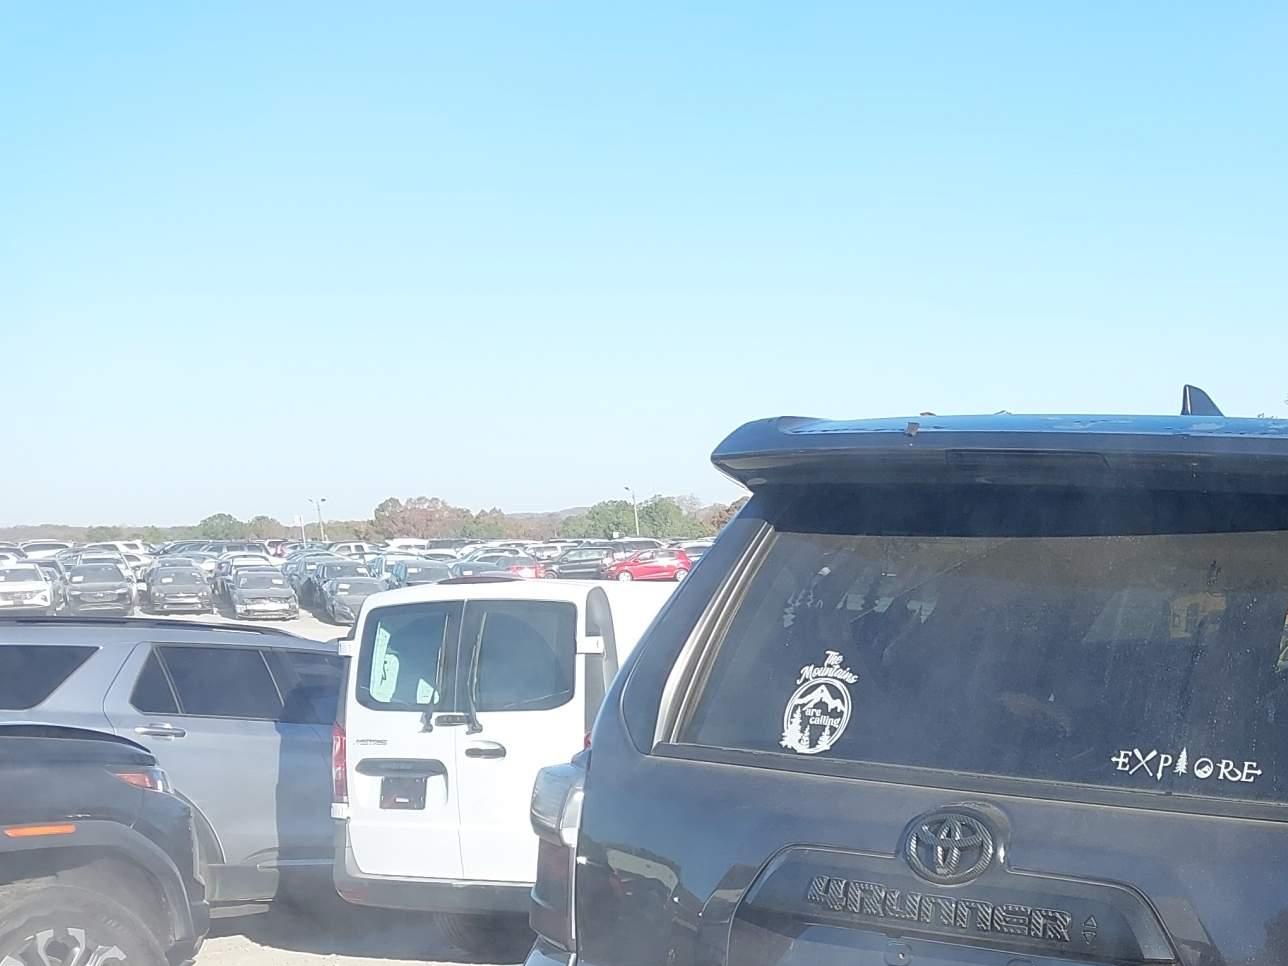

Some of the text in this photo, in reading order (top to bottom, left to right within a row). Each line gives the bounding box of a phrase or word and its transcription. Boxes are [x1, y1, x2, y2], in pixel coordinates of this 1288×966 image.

[825, 650, 843, 666] The
[796, 664, 859, 685] Mountains
[805, 707, 821, 717] are
[809, 715, 841, 729] calling
